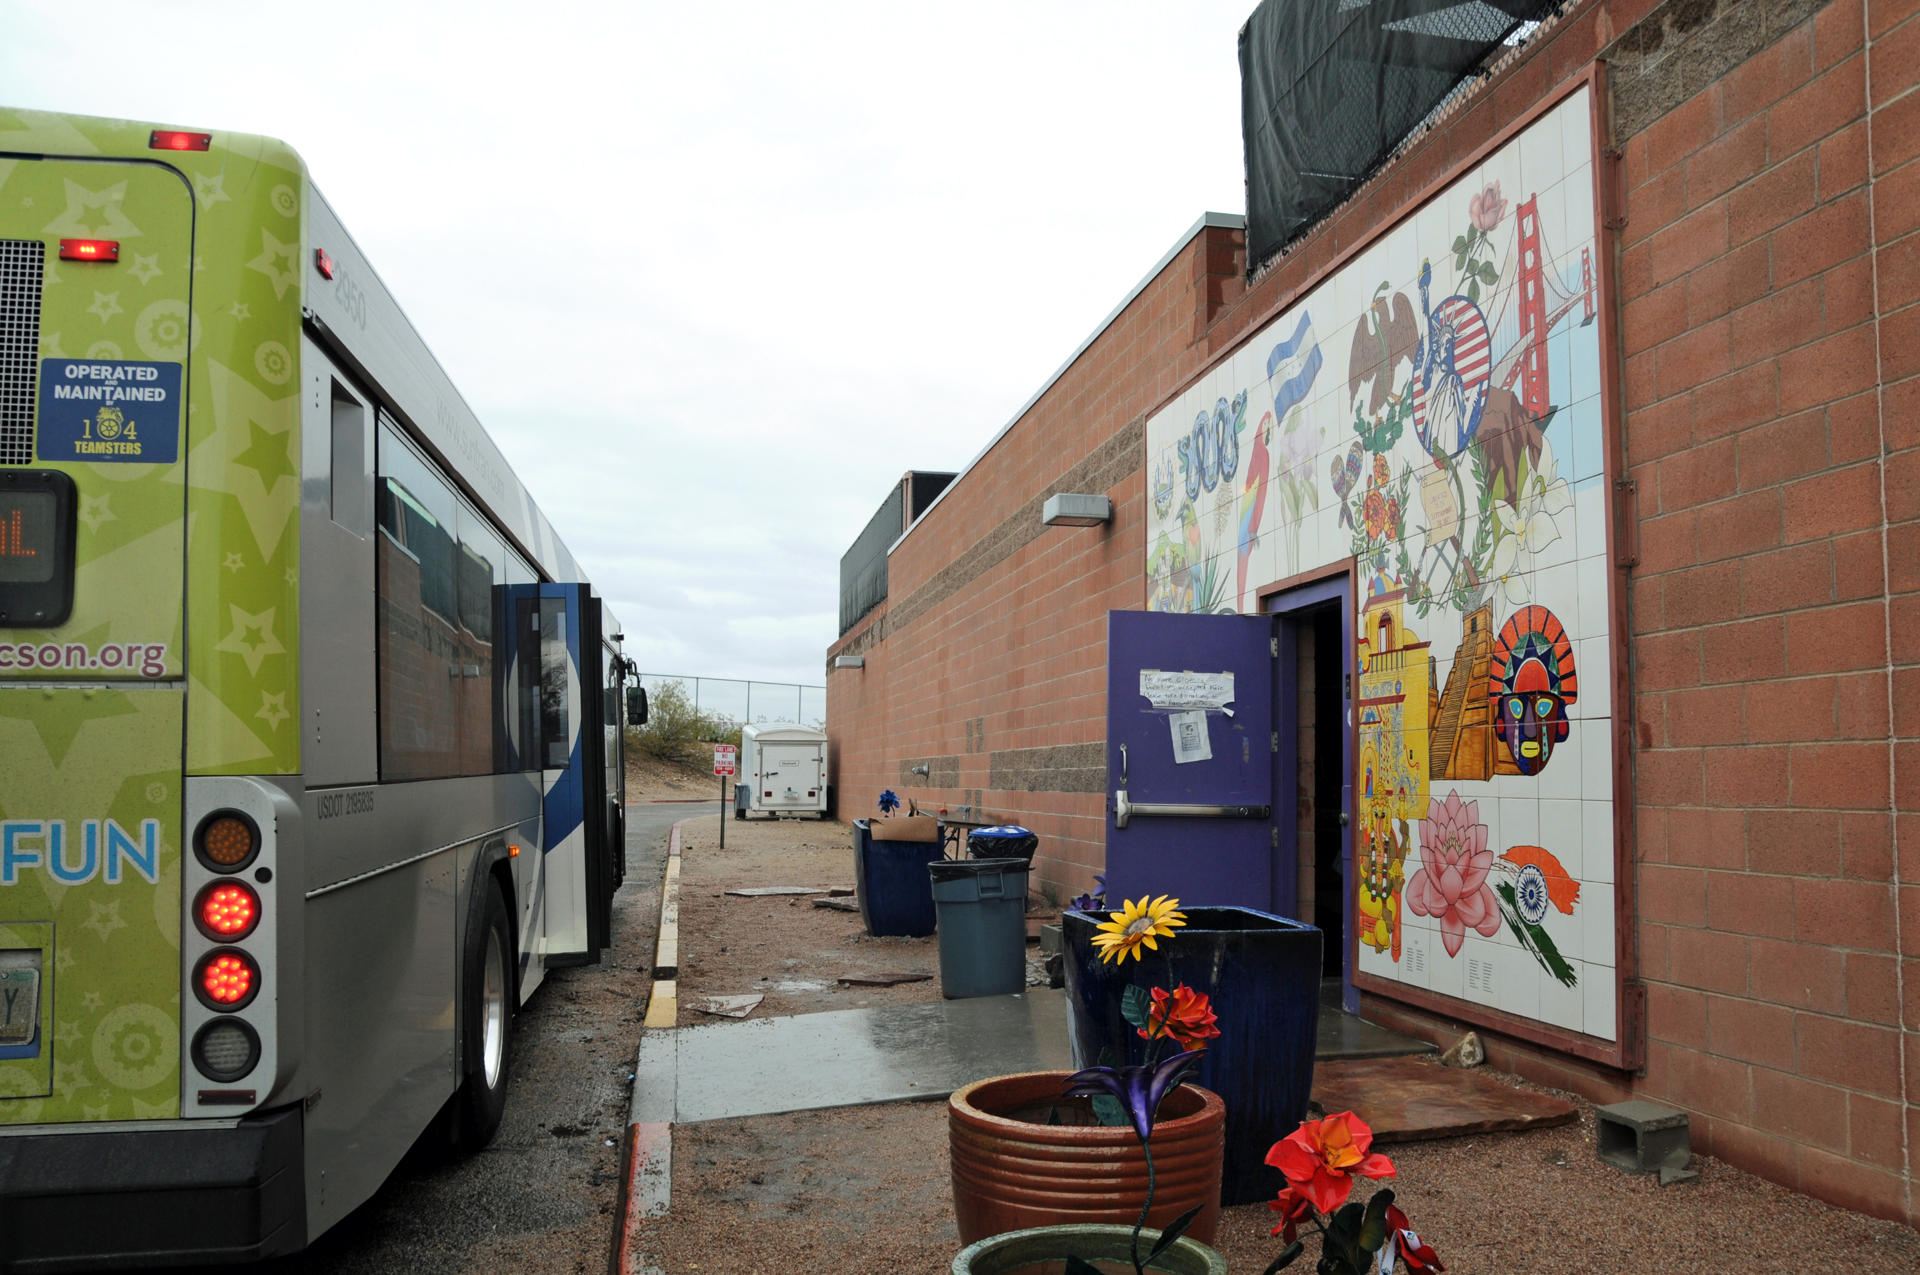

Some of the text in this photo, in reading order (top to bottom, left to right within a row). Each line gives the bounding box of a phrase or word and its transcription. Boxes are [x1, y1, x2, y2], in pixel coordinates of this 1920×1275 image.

[335, 260, 366, 332] 2950
[65, 364, 159, 381] OPERATED
[54, 384, 166, 402] MAINTAINED
[74, 441, 142, 455] TEAMSTERS
[317, 794, 343, 820] USDOT
[2, 823, 156, 882] FUN
[4, 988, 19, 1025] Y
